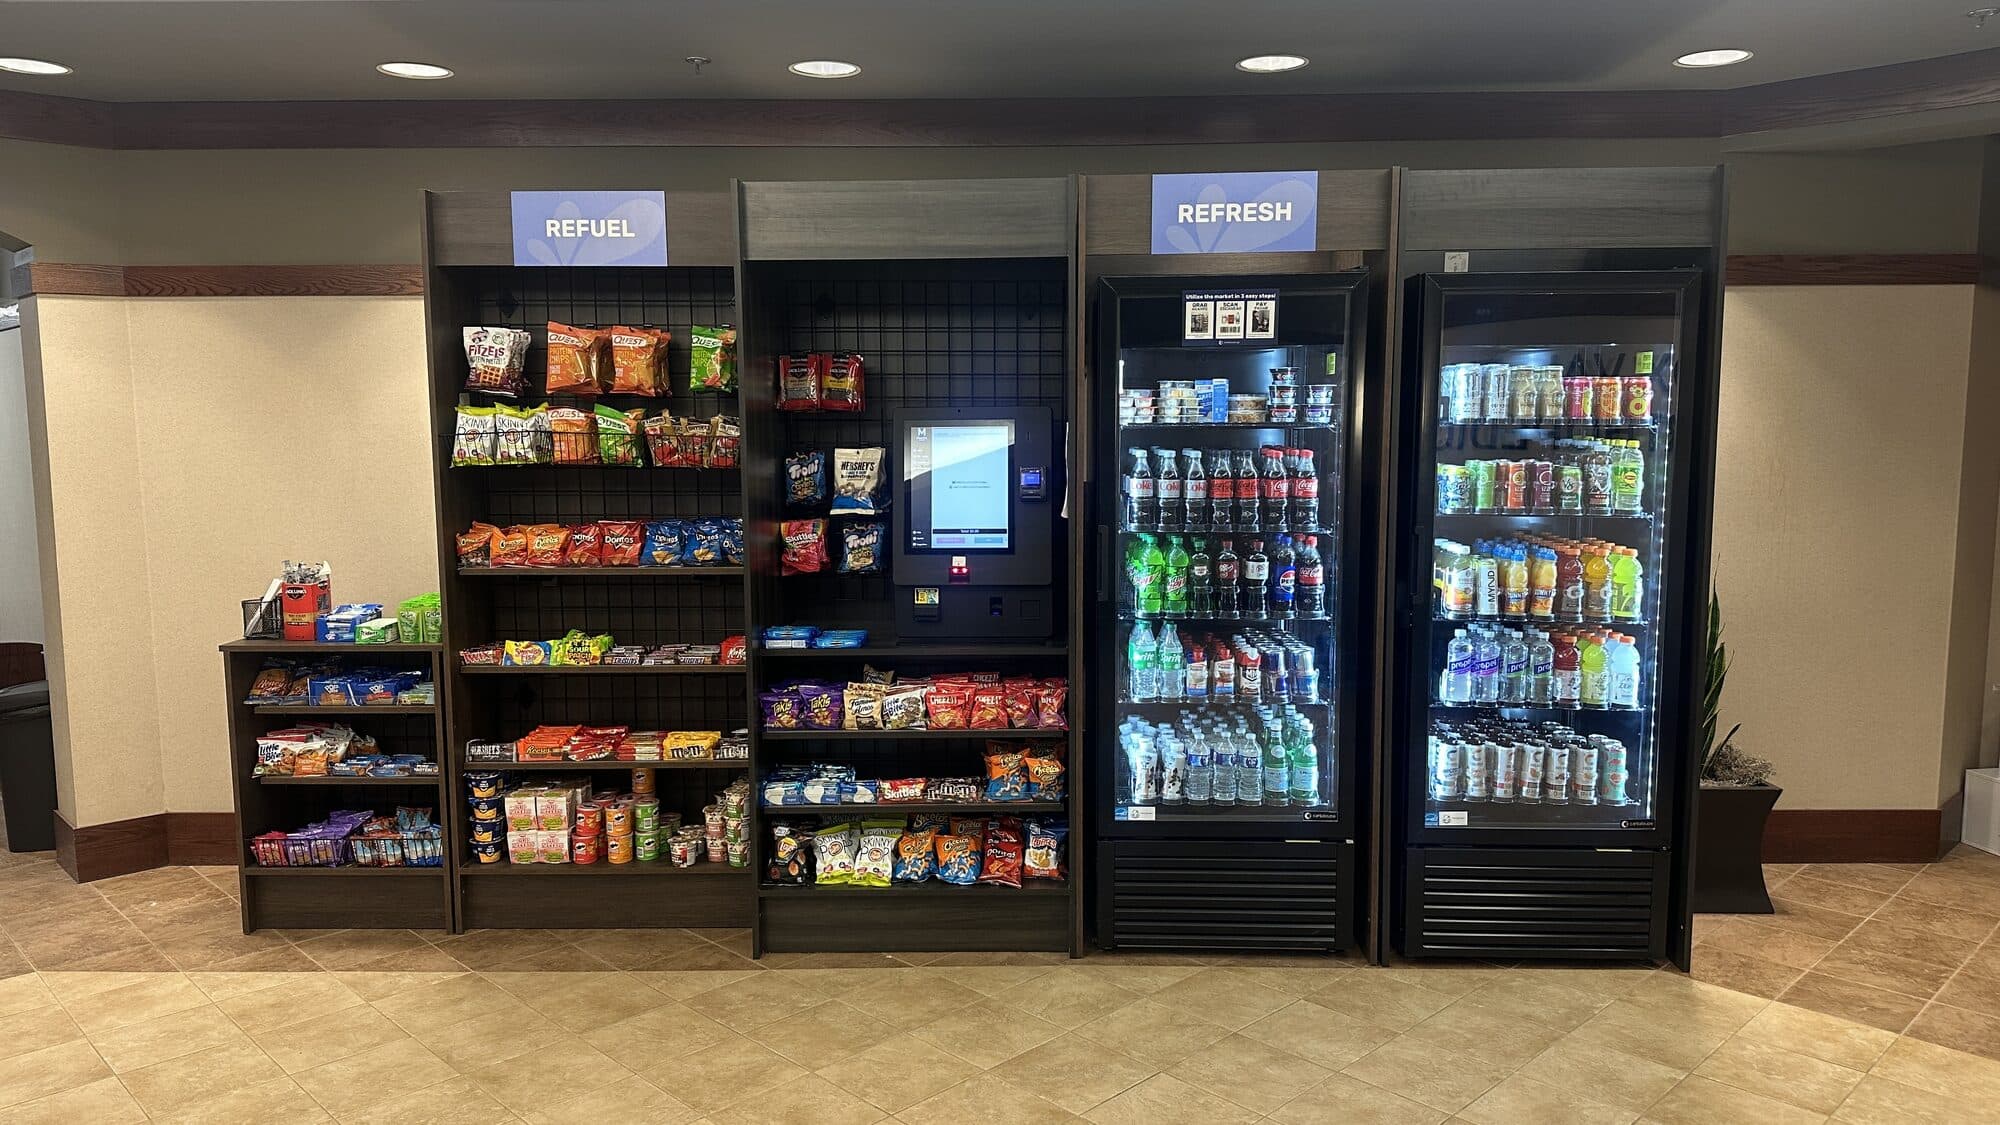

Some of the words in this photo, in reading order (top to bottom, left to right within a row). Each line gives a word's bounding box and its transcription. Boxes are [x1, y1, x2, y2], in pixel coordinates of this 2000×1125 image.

[1178, 202, 1292, 223] REFRESH
[546, 219, 636, 238] REFUEL
[613, 335, 644, 346] QUEST
[460, 416, 489, 429] SKINNY
[788, 459, 820, 480] Trolli
[840, 461, 876, 472] HERSHEY'S
[604, 534, 634, 545] Doritos
[785, 533, 819, 543] Skittles
[845, 530, 878, 549] Trolli
[1487, 570, 1496, 603] MYND
[810, 694, 832, 709] Takis
[259, 743, 280, 757] Little
[265, 751, 286, 763] Bites
[884, 786, 921, 800] Skittles
[987, 848, 1016, 859] Doritos
